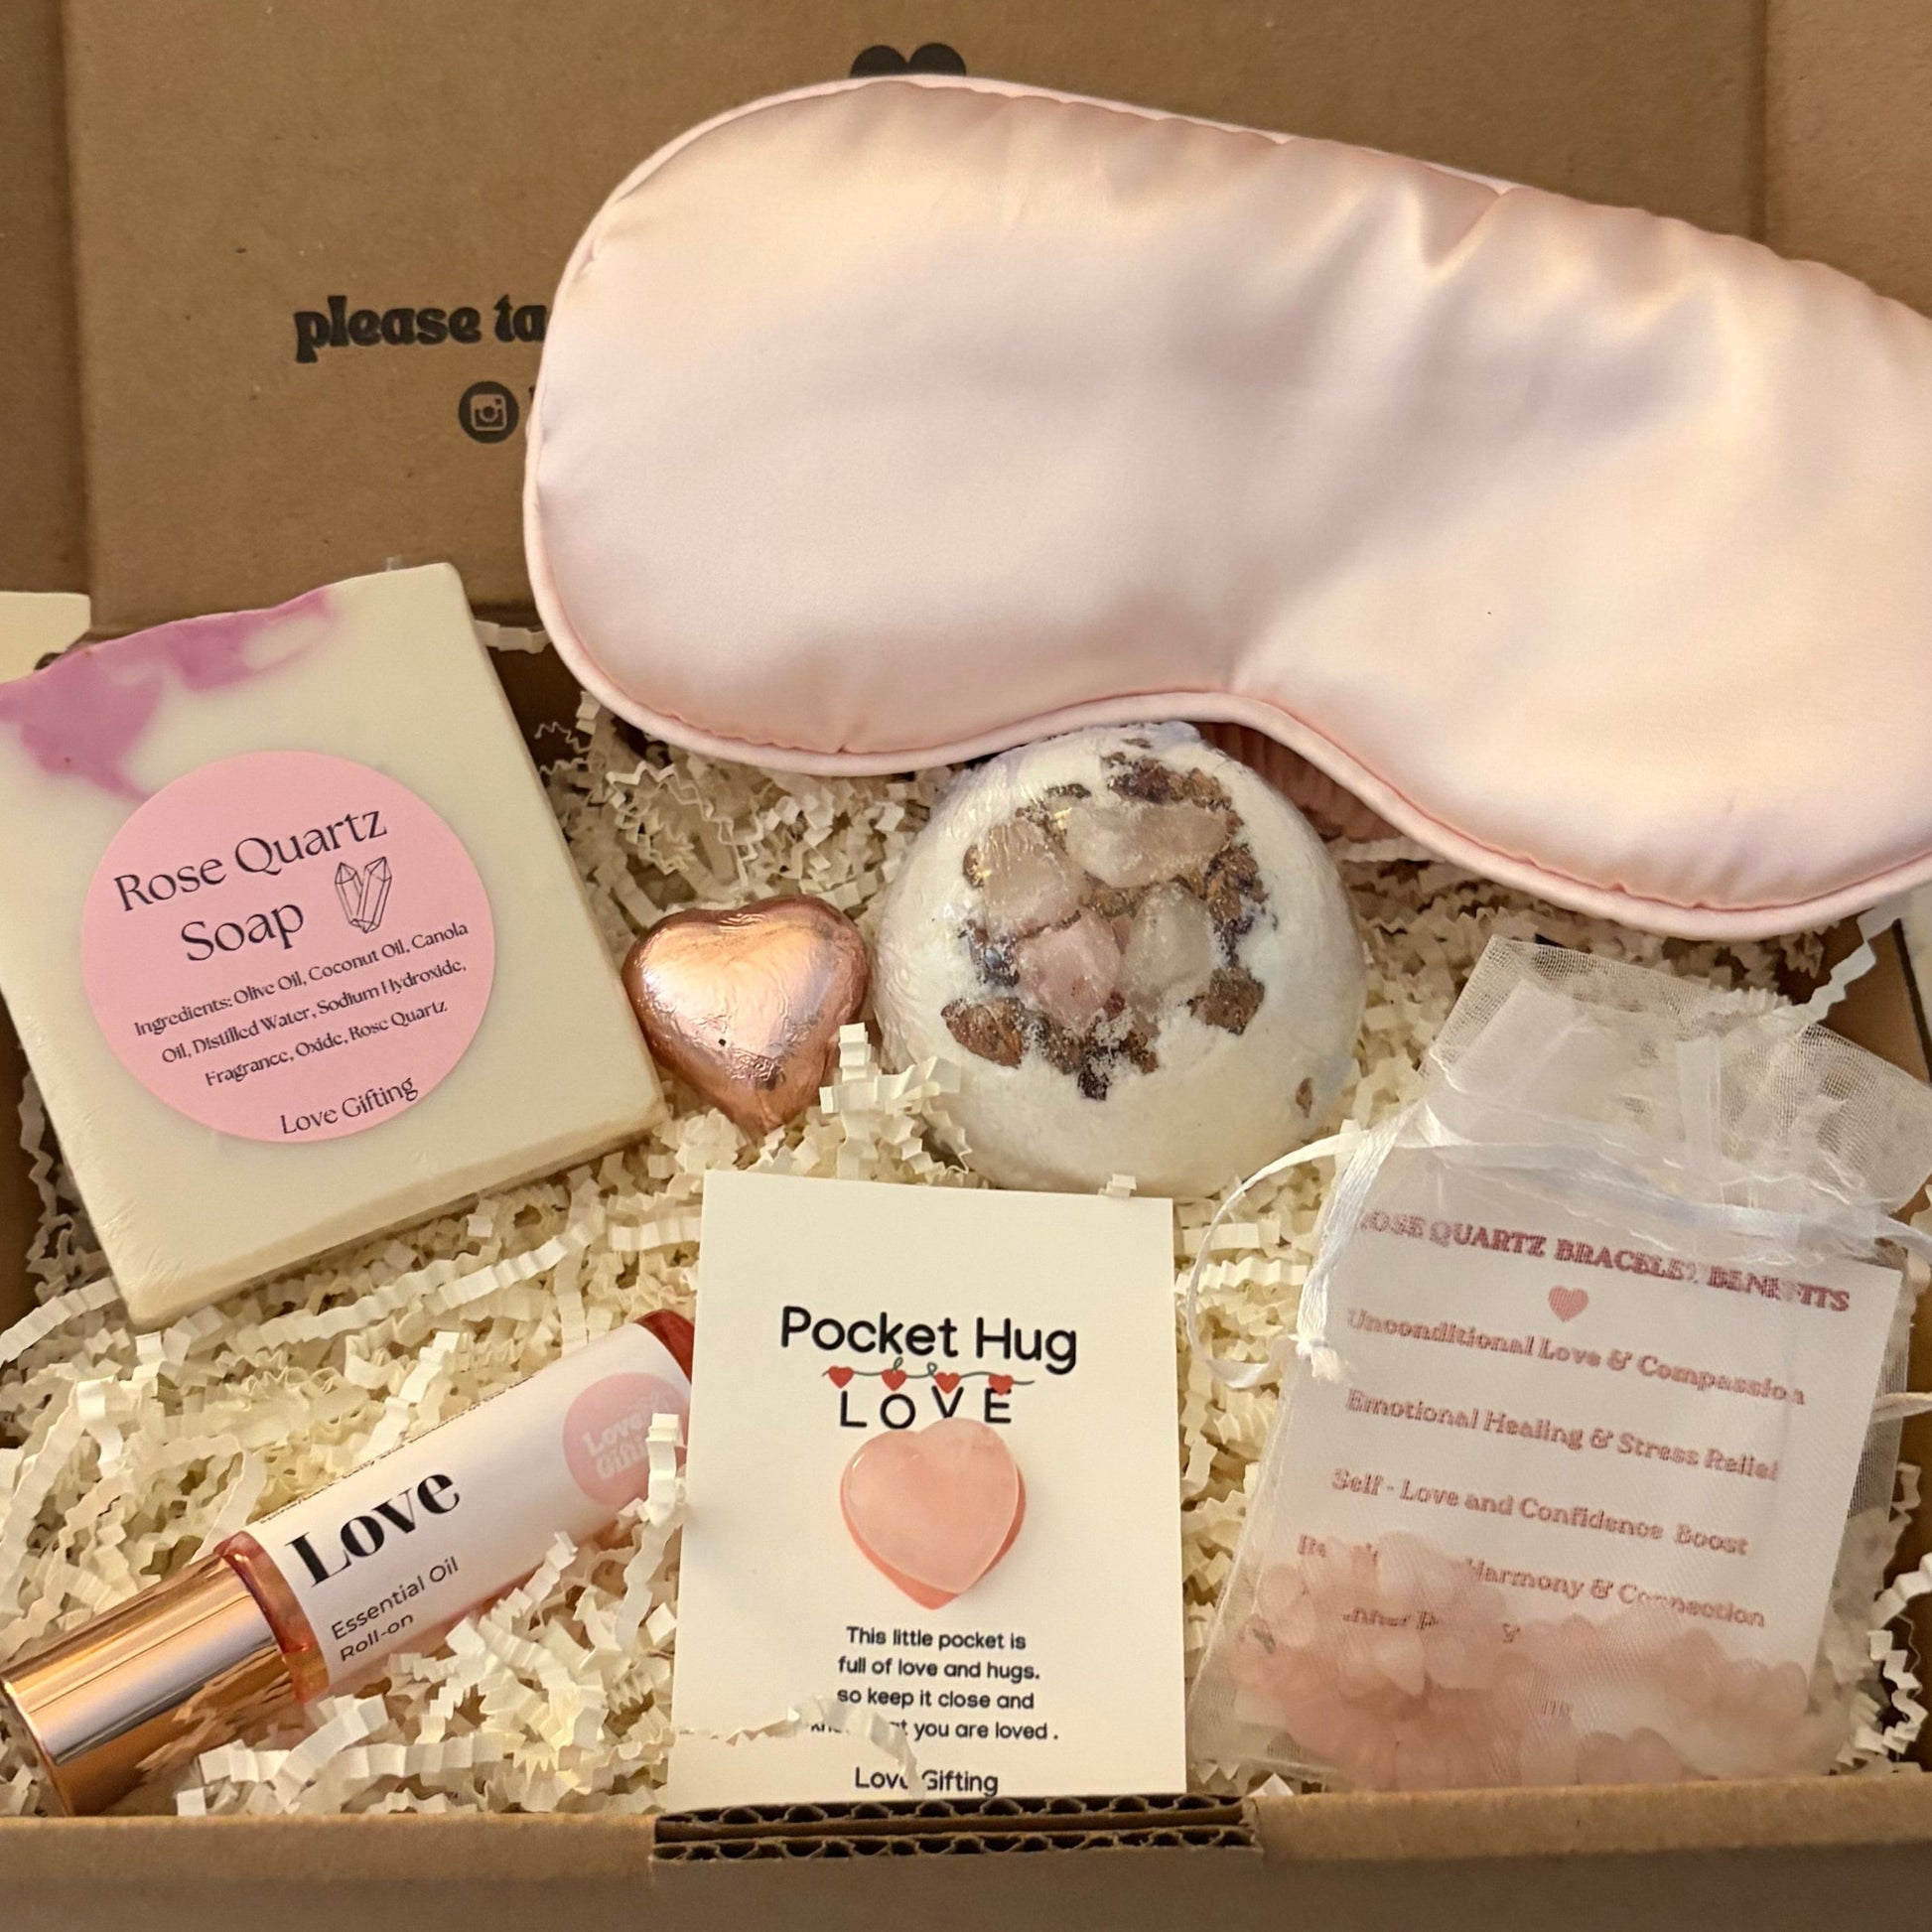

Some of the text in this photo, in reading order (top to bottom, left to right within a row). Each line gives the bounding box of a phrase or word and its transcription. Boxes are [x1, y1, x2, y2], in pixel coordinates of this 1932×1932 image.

[293, 294, 548, 364] please ta
[113, 809, 387, 911] Rose Quartz
[181, 902, 305, 962] Soap
[134, 994, 232, 1036] Ingredients:
[233, 982, 276, 1006] Olive
[277, 972, 307, 993] Oil,
[308, 950, 379, 981] Coconut
[411, 921, 469, 950] Canola
[161, 959, 468, 1064] Oil, Distilled Water, Sodium Hydroxide,
[205, 1000, 449, 1087] Fragrance, Oxide, Rose Quartz
[280, 1076, 418, 1135] Love Gifting
[1429, 1220, 1548, 1258] QUARTZ
[781, 1306, 1078, 1375] Pocket Hug
[1347, 1307, 1806, 1405] Unconditional Love & Compassion
[840, 1386, 1013, 1430] LOVE
[1346, 1389, 1479, 1430] Emotional
[1483, 1408, 1584, 1450] Healing
[1589, 1428, 1613, 1449] &
[1617, 1432, 1700, 1465] Stress
[286, 1473, 460, 1587] Love
[1331, 1467, 1384, 1496] Self
[1400, 1478, 1459, 1507] Love
[1463, 1495, 1514, 1516] and
[1518, 1497, 1664, 1540] Confidence
[1673, 1522, 1749, 1556] Boost
[332, 1557, 460, 1640] Essential Oil
[1589, 1579, 1613, 1599] &
[340, 1614, 414, 1662] Roll-on
[838, 1655, 1039, 1684] full of love and hugs.
[847, 1626, 1027, 1651] This little pocket is
[837, 1688, 1035, 1710] so keep it close and
[914, 1723, 949, 1741] you
[955, 1724, 989, 1738] are
[996, 1722, 1047, 1740] loved
